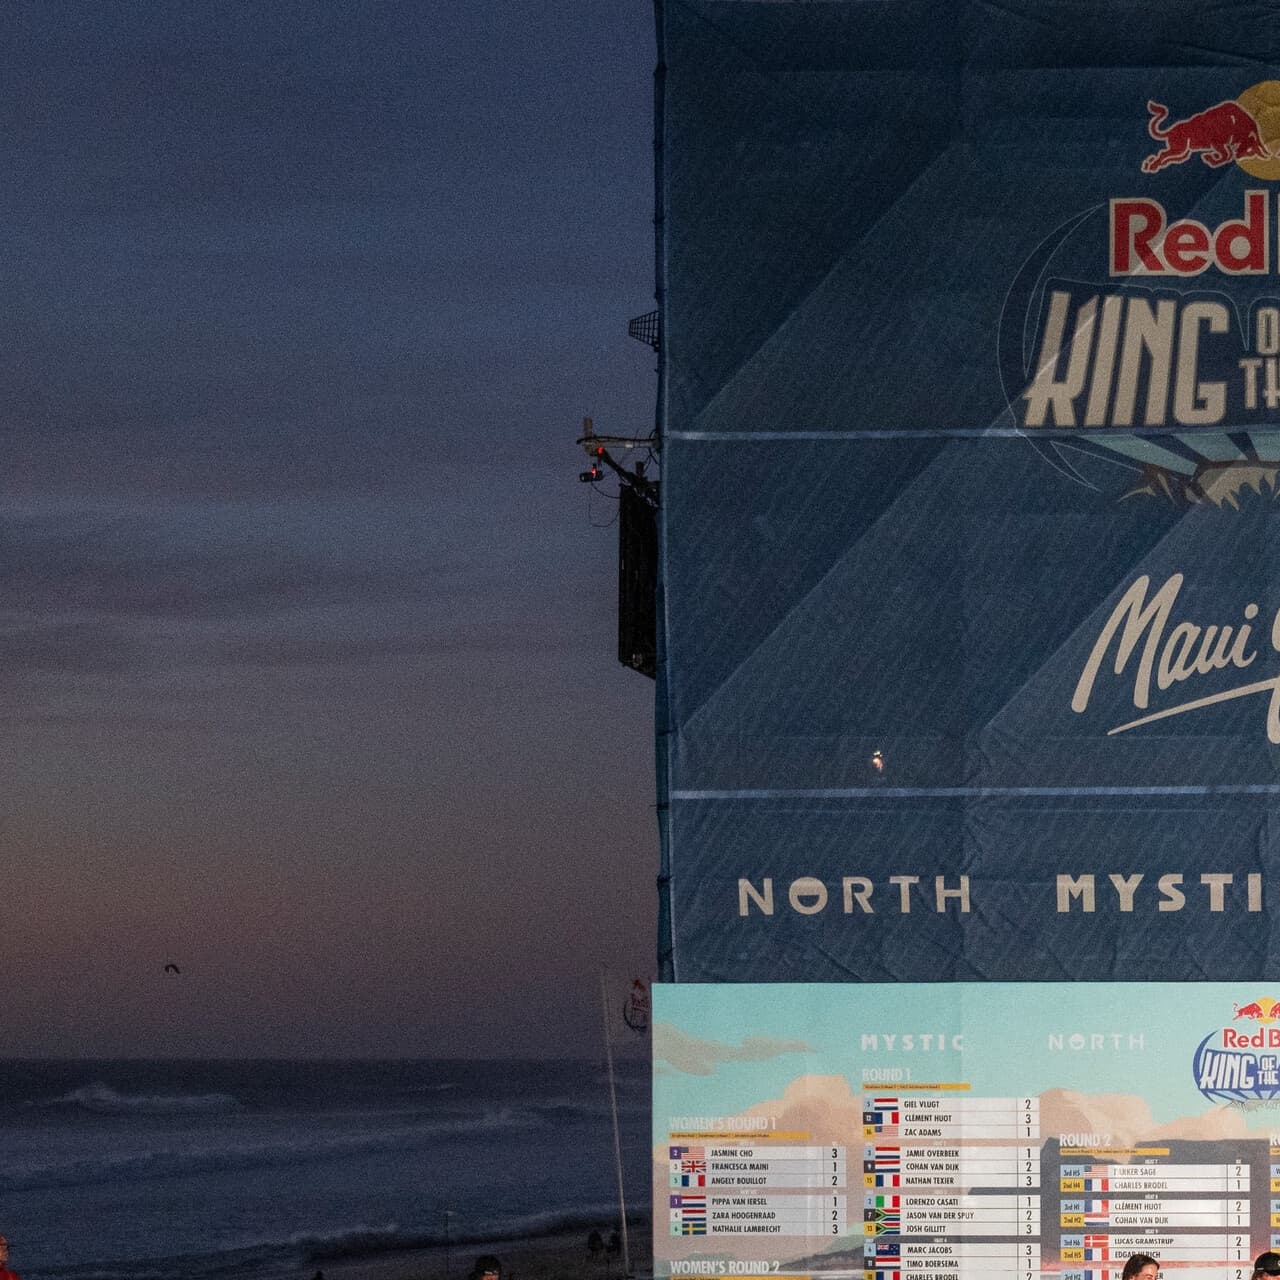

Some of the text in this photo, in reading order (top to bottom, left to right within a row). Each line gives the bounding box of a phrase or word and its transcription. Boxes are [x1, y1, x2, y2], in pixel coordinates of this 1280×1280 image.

[1109, 189, 1269, 276] Red
[1023, 291, 1231, 427] KING
[1072, 573, 1256, 713] Maui
[739, 876, 971, 915] NORTH
[861, 1034, 964, 1051] MYSTIC
[1048, 1033, 1145, 1050] NORTH
[1224, 1028, 1264, 1048] Red
[1200, 1051, 1256, 1088] KING
[1261, 1056, 1275, 1070] OF
[1257, 1071, 1278, 1085] THE
[770, 1117, 776, 1130] 1
[1060, 1134, 1110, 1146] ROUND 2
[712, 1198, 745, 1206] PIPPA VAN
[670, 1260, 770, 1274] WOMEN'S ROUND
